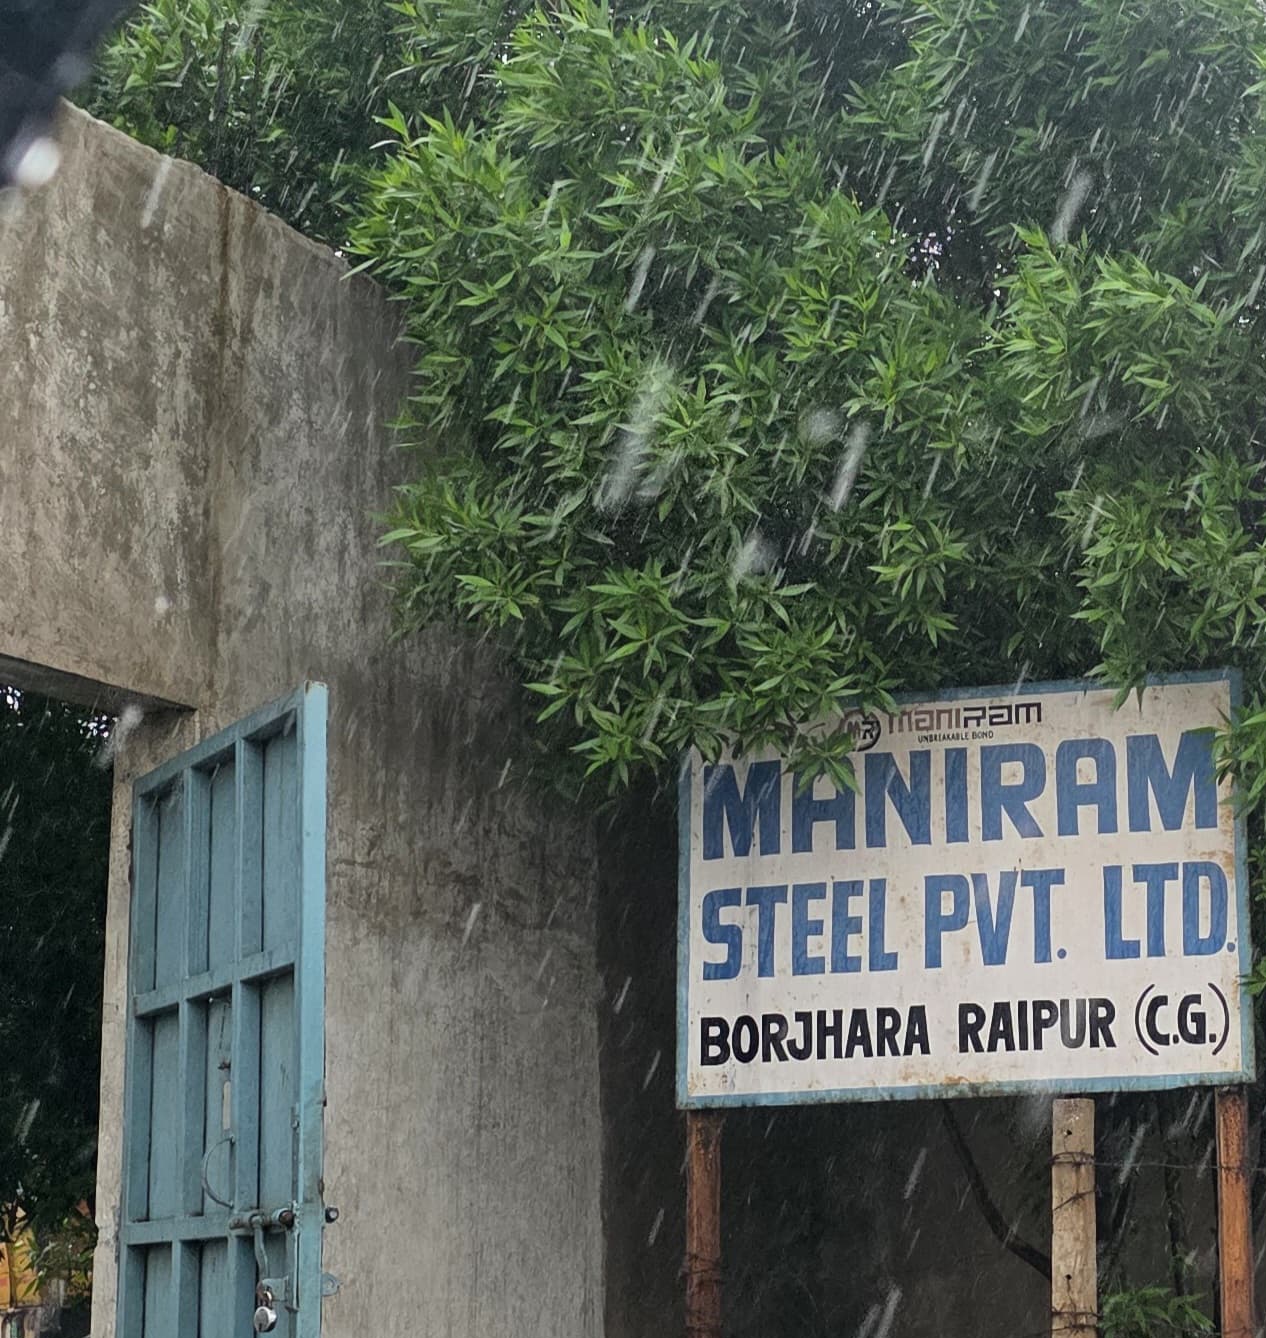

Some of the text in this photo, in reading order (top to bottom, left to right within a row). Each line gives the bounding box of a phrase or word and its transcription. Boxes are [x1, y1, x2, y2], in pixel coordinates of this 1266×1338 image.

[917, 730, 994, 744] UNBREAKABLE BOND
[702, 729, 1218, 861] MANIRAM
[702, 860, 1236, 981] STEEL PVT. LTD.
[699, 982, 1230, 1066] BORJHARA RAIPUR (C.G.)
